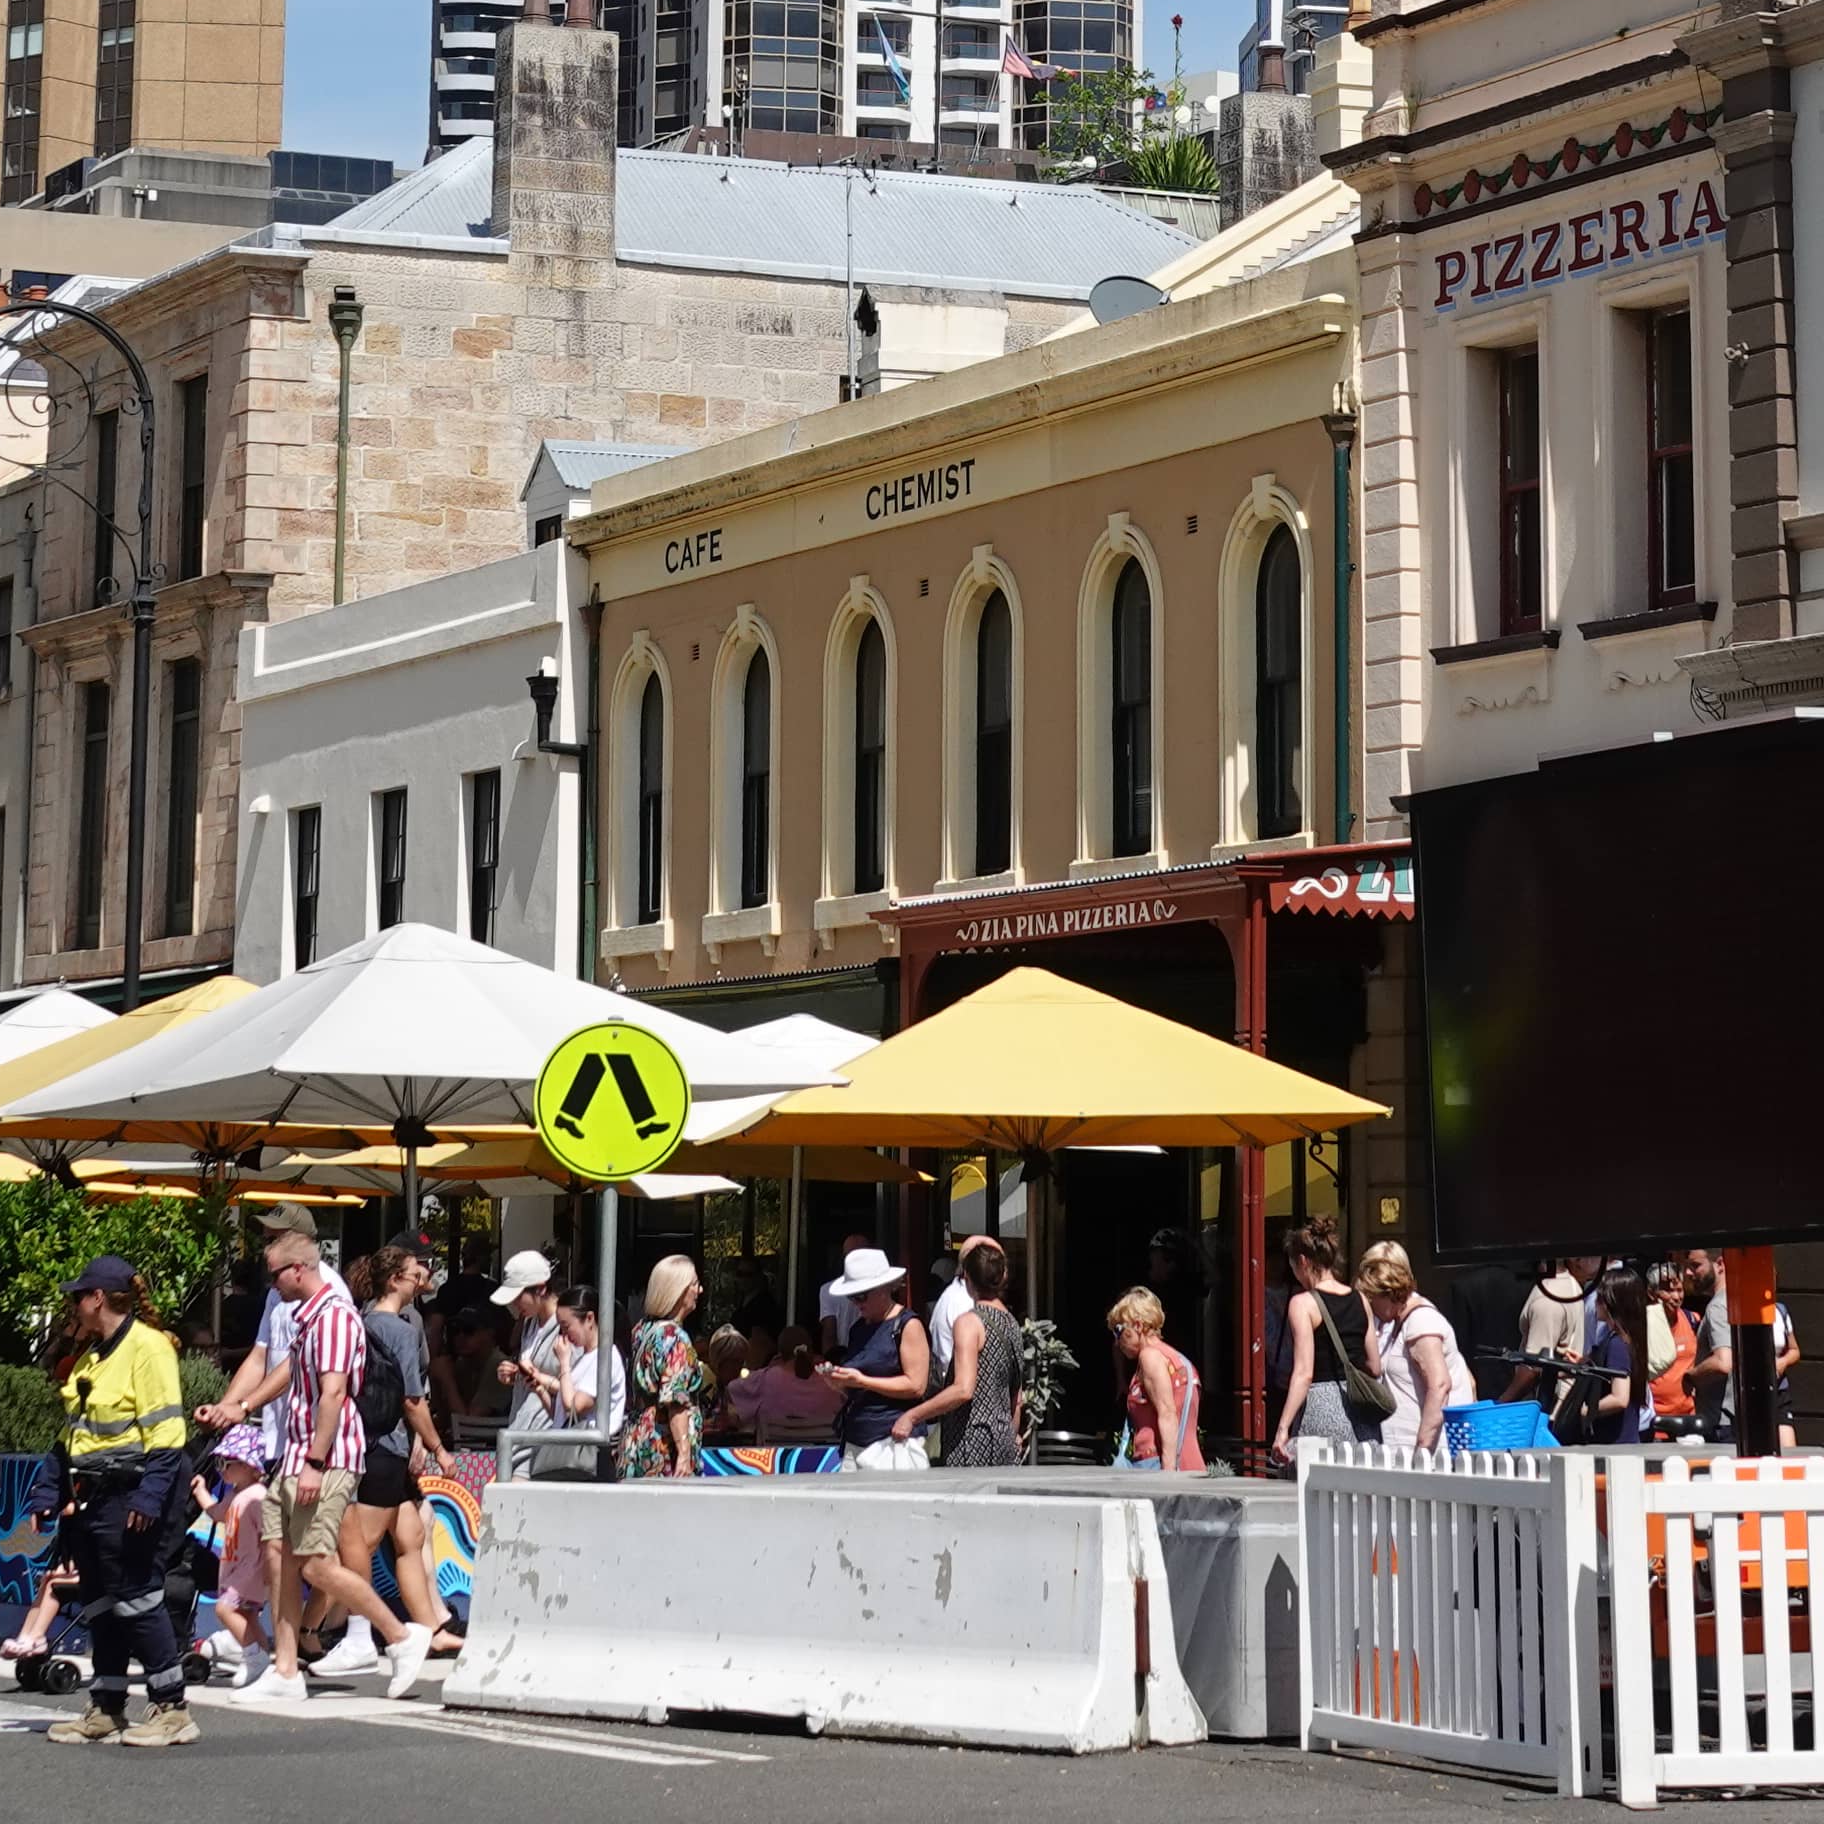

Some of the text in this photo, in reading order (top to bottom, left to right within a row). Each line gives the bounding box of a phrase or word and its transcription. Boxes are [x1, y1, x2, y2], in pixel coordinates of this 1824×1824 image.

[1433, 179, 1727, 310] PIZZERIA
[664, 458, 976, 574] CAFE CHEMIST
[980, 901, 1151, 942] ZIA PINA PIZZERIA
